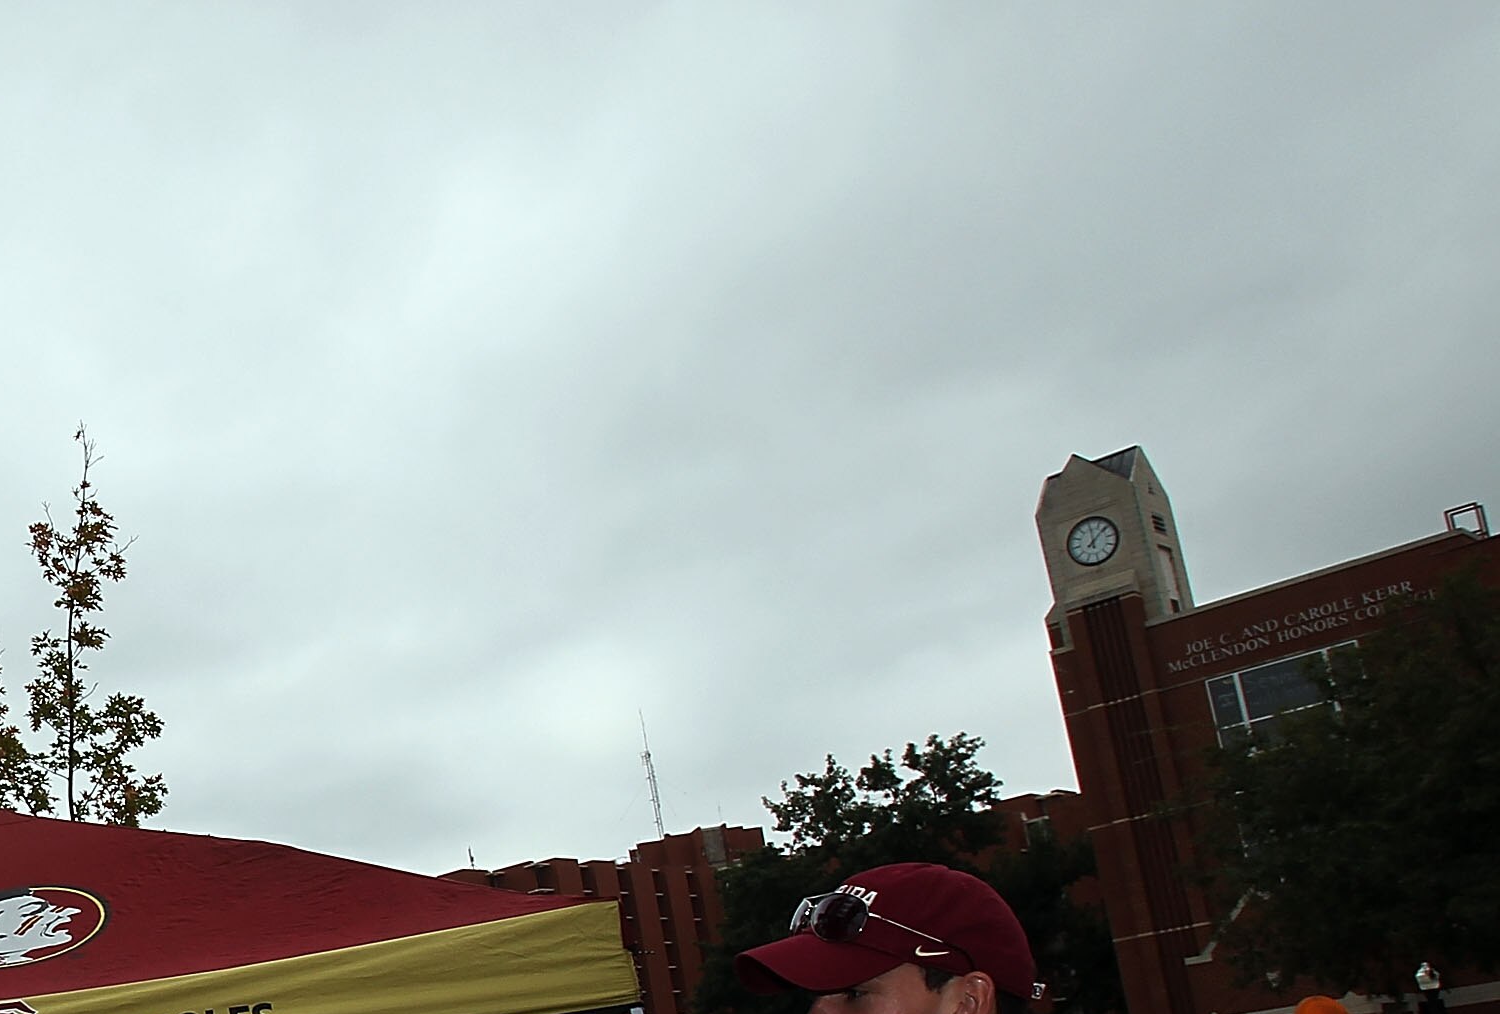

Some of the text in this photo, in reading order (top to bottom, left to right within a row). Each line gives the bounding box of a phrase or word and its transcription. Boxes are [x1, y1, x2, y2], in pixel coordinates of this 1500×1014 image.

[1168, 635, 1271, 673] McCLENDON
[1277, 613, 1349, 644] HONORS
[1185, 636, 1213, 656] JOE
[1243, 618, 1279, 636] AND
[1284, 598, 1354, 626] CAROLE
[1361, 580, 1414, 605] KERR
